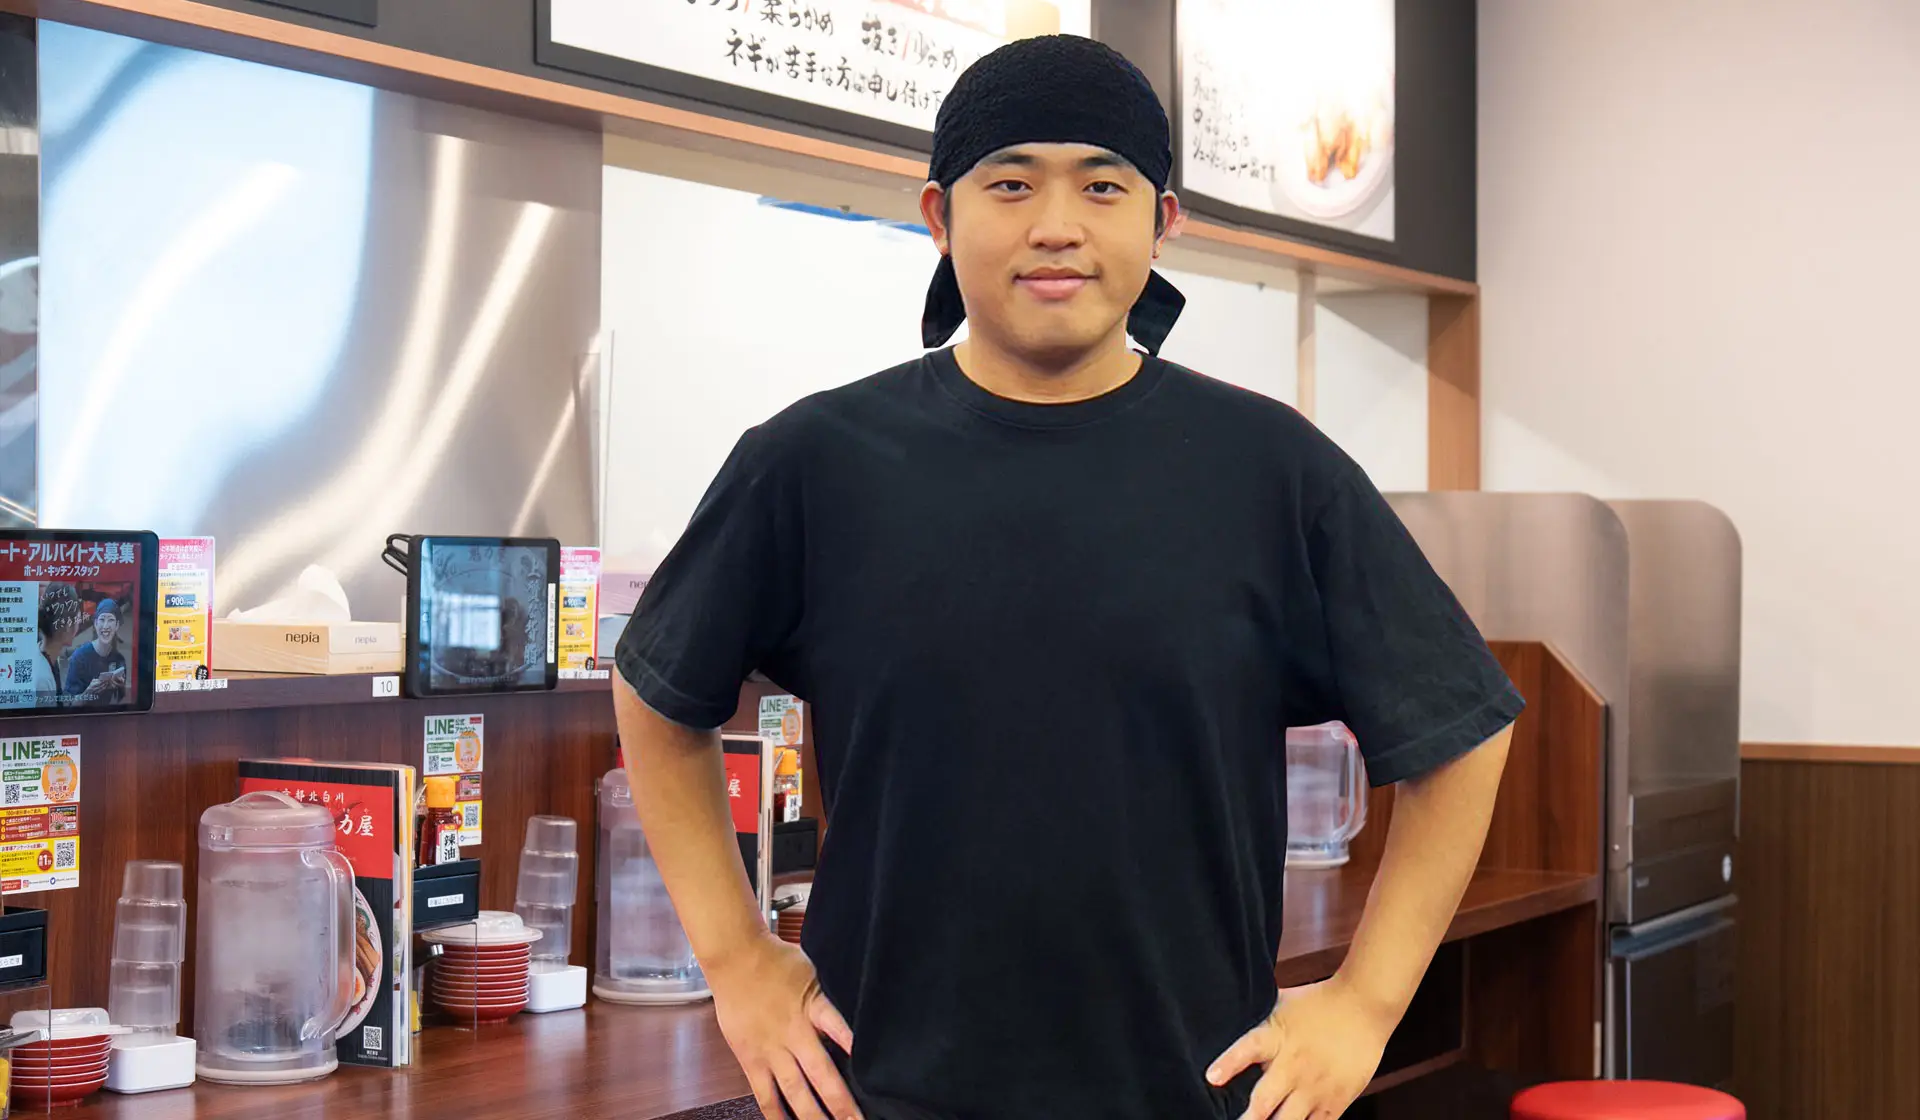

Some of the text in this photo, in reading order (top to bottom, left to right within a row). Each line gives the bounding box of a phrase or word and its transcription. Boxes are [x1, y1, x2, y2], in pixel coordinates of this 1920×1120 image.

[23, 565, 100, 577] ホール・キッチンスタッフ
[285, 632, 320, 644] nepia
[355, 636, 377, 644] nepia
[381, 680, 392, 693] 10
[761, 698, 782, 713] LINE
[427, 719, 454, 735] LINE
[3, 741, 40, 760] LINE
[42, 740, 55, 749] 公式
[42, 748, 70, 758] アカウント
[338, 814, 374, 836] 力屋
[444, 833, 456, 860] 辣油
